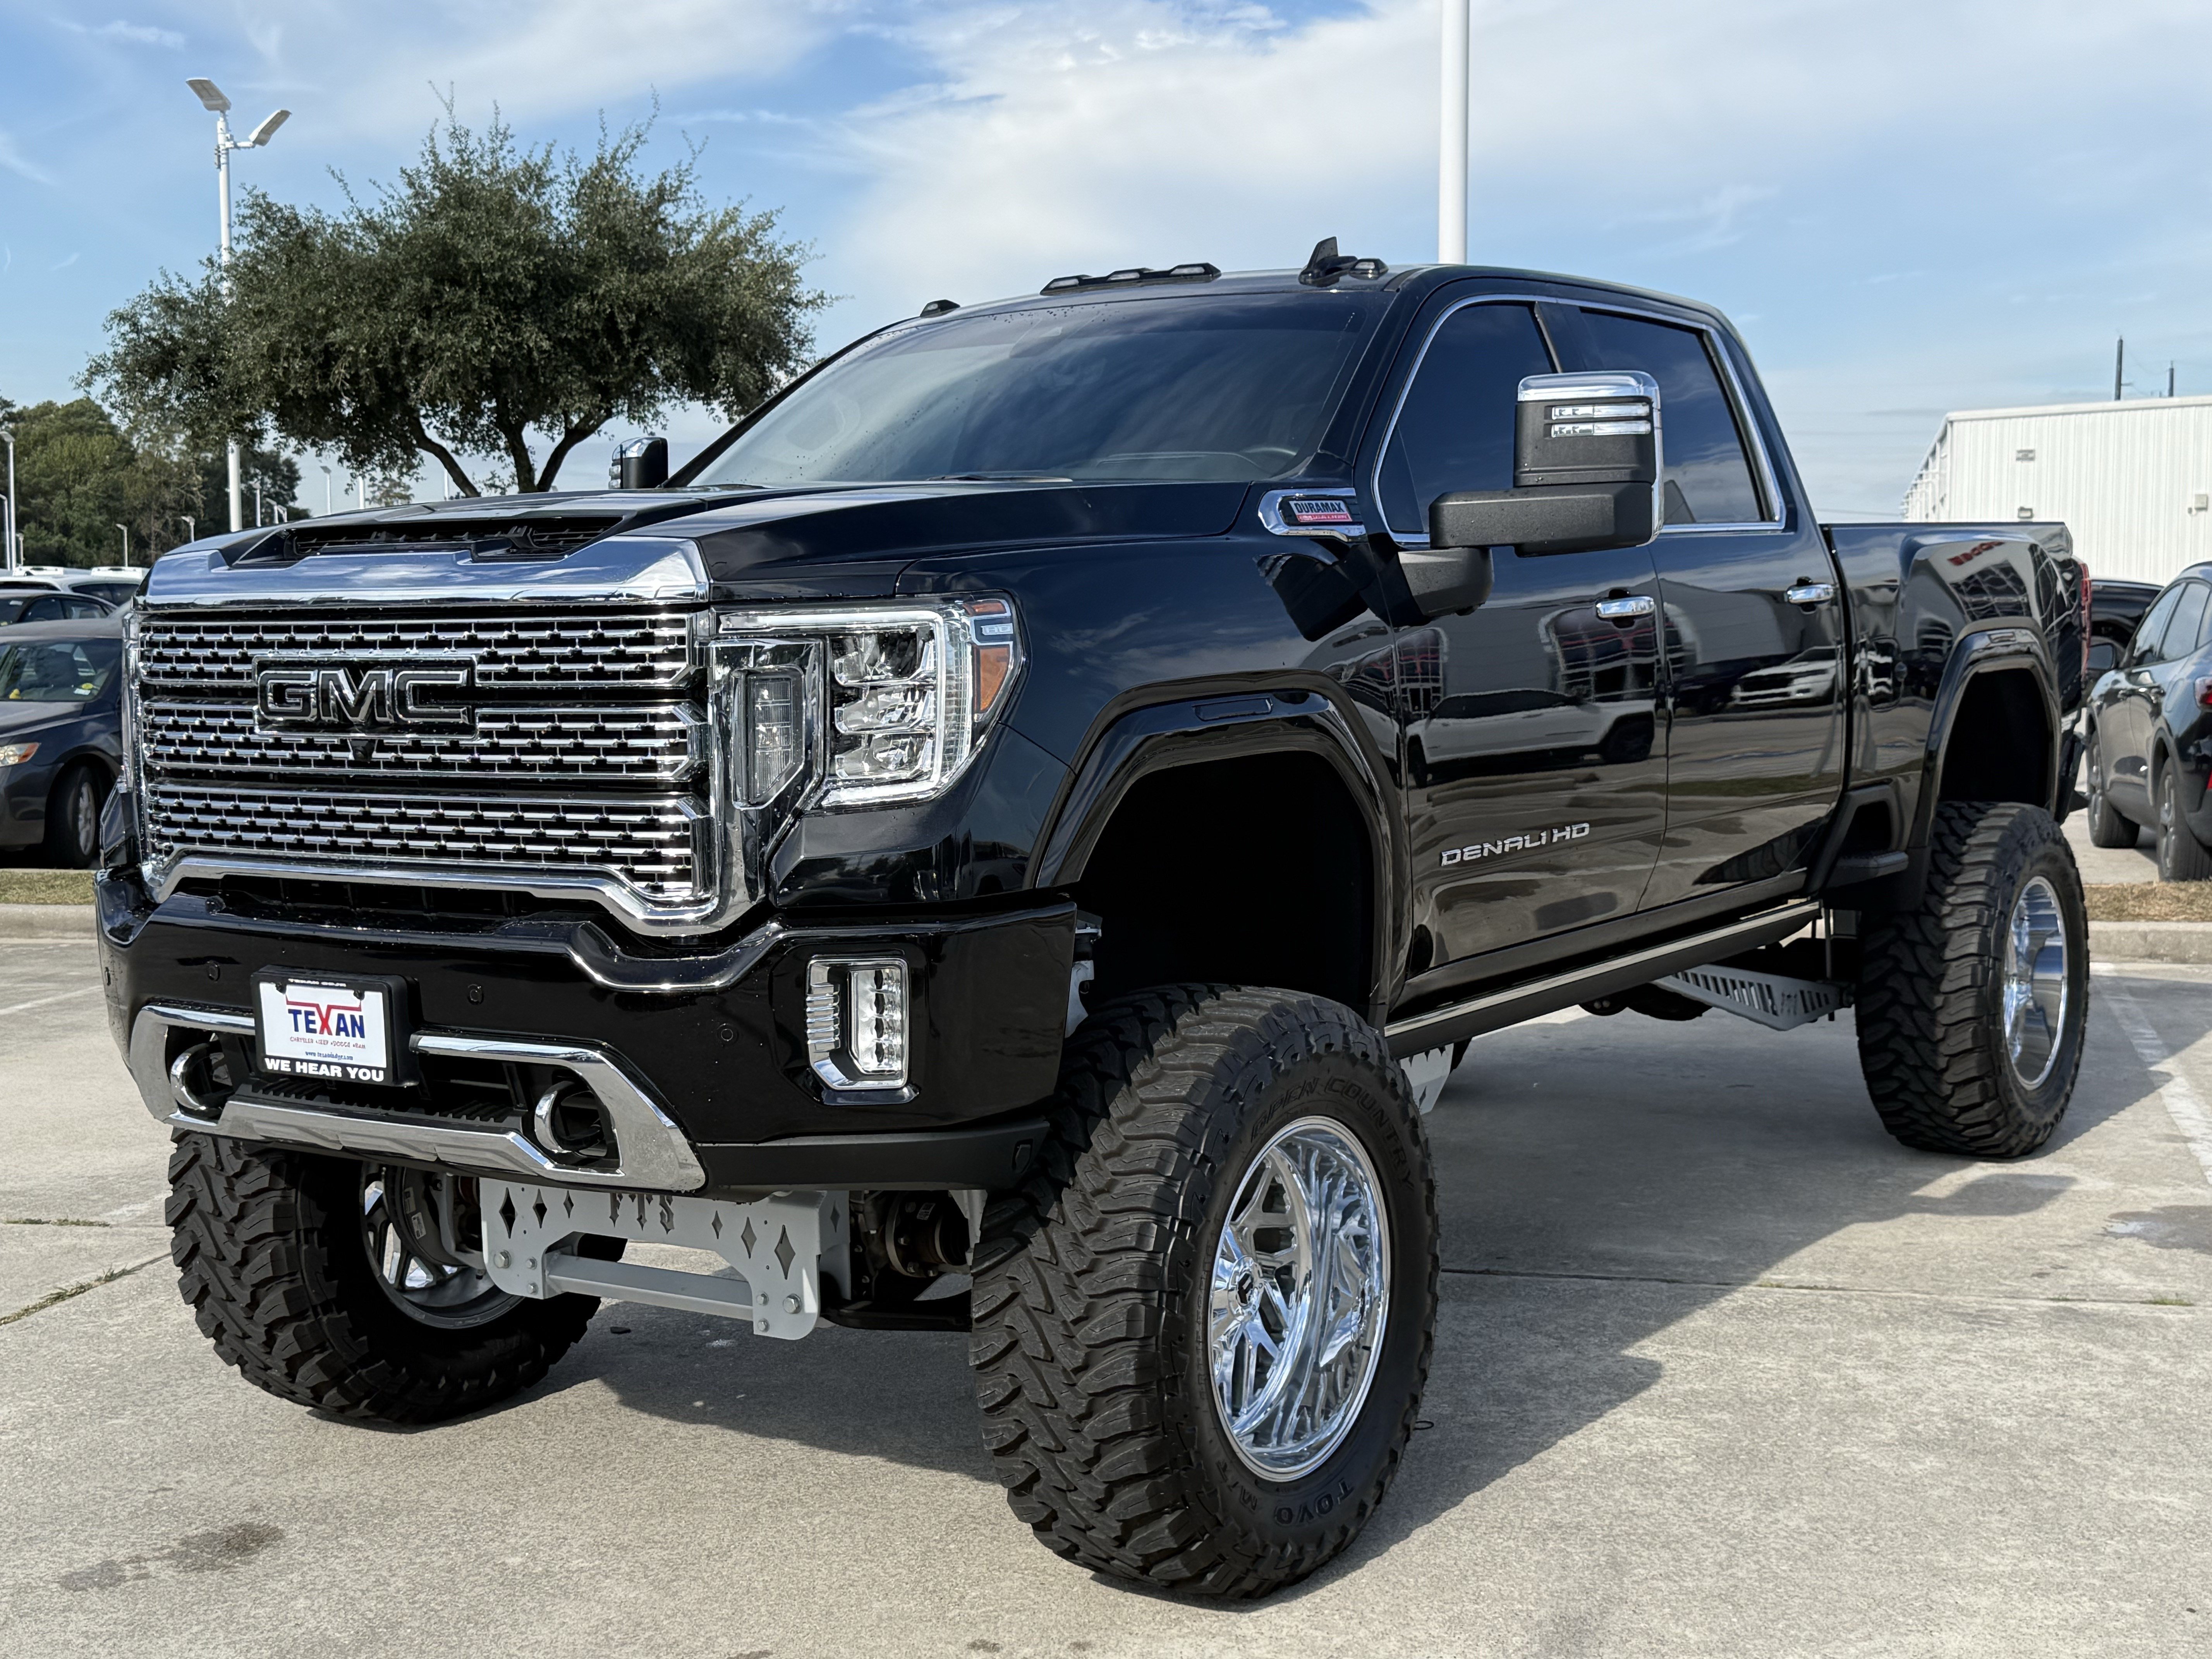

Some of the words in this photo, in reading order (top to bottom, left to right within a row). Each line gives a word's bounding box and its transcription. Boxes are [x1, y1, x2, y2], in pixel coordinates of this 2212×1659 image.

[1294, 502, 1345, 513] DURAMAX
[258, 668, 469, 723] GMC
[1440, 831, 1546, 867] DENALI
[1552, 822, 1589, 843] HD
[288, 1003, 365, 1039] TEXAN
[265, 1058, 290, 1072] WE
[296, 1061, 342, 1077] HEAR
[347, 1066, 384, 1082] YOU
[1251, 1077, 1319, 1143] OPEN
[1324, 1075, 1415, 1189] COUNTRY
[1273, 1478, 1355, 1528] TOYO
